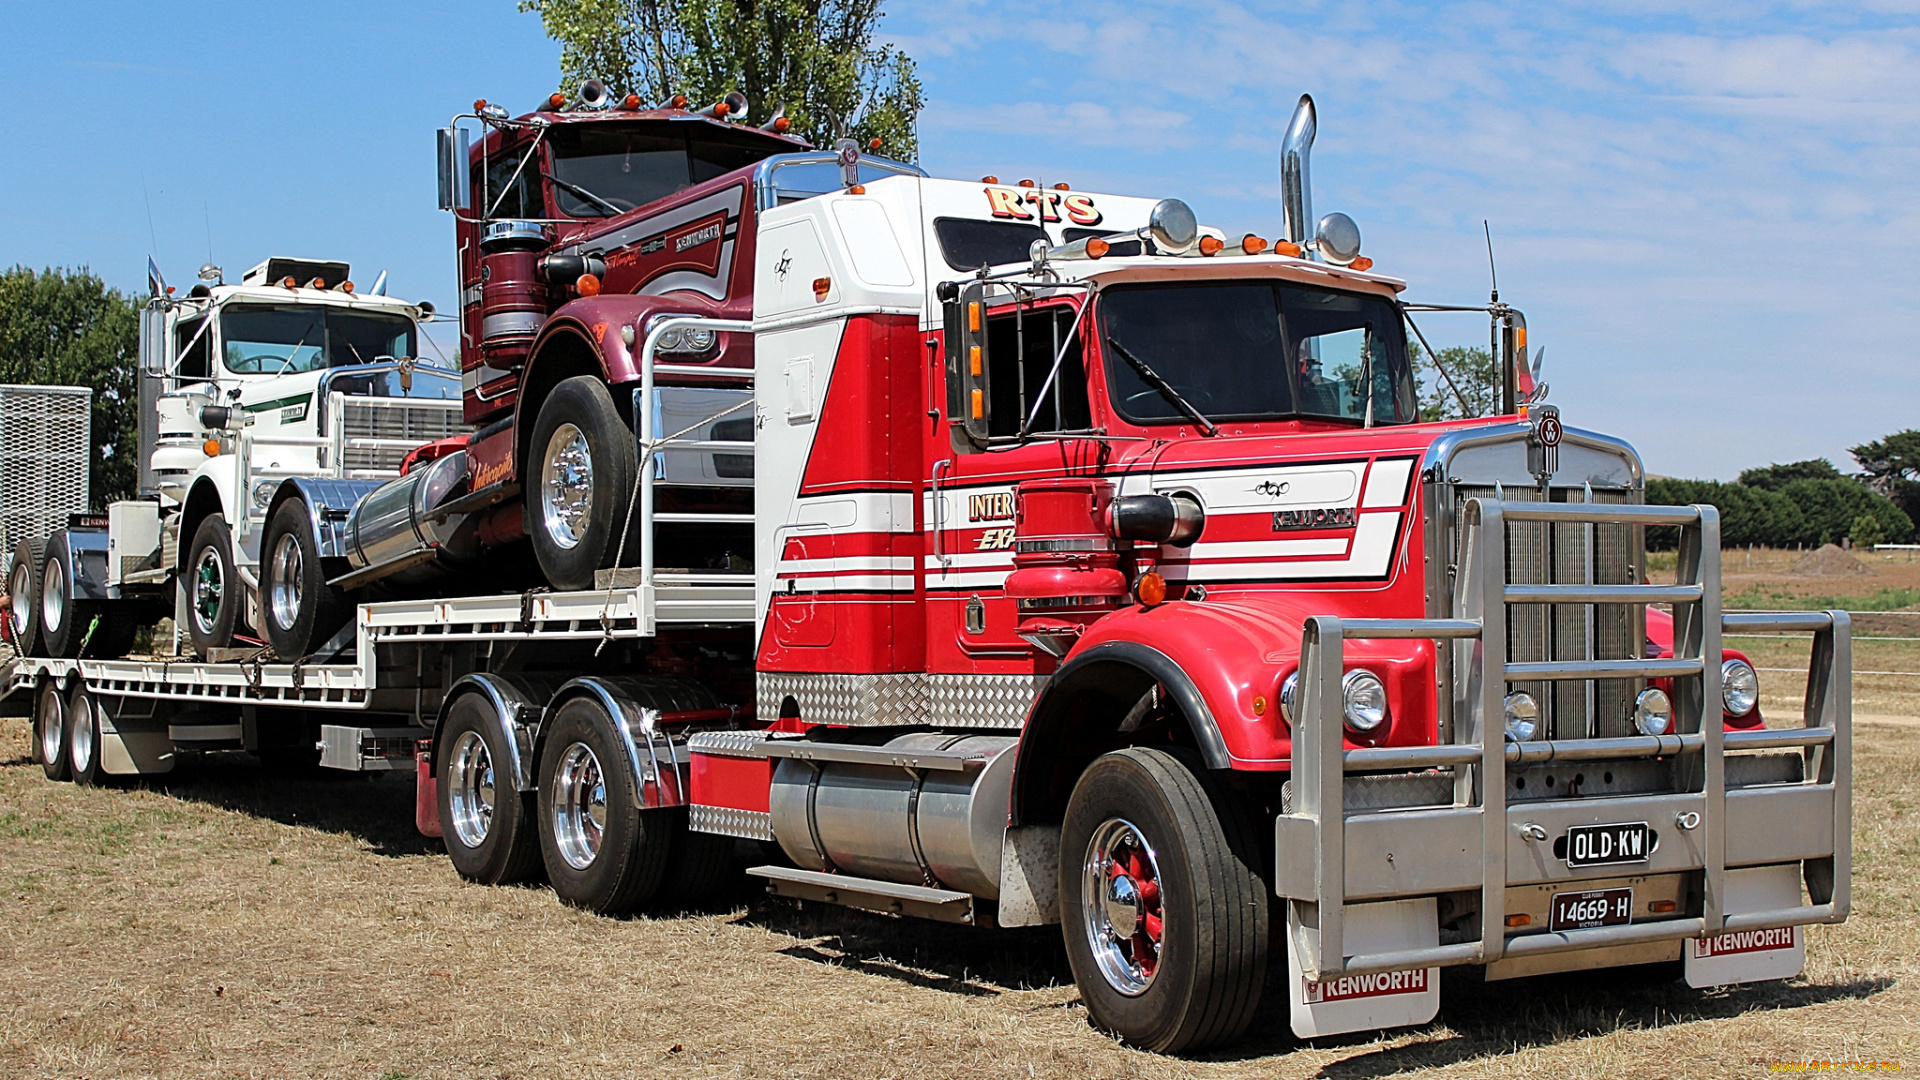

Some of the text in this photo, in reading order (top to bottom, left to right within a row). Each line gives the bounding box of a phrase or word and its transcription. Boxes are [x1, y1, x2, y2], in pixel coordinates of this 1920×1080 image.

[984, 187, 1104, 227] RTS
[676, 223, 721, 253] KENWORTH
[969, 492, 1015, 522] INTER
[1273, 507, 1356, 531] KENWORTH
[1578, 920, 1604, 929] VICTORIA
[1713, 927, 1792, 953] KENWORTH
[1326, 968, 1425, 998] KENWORTH
